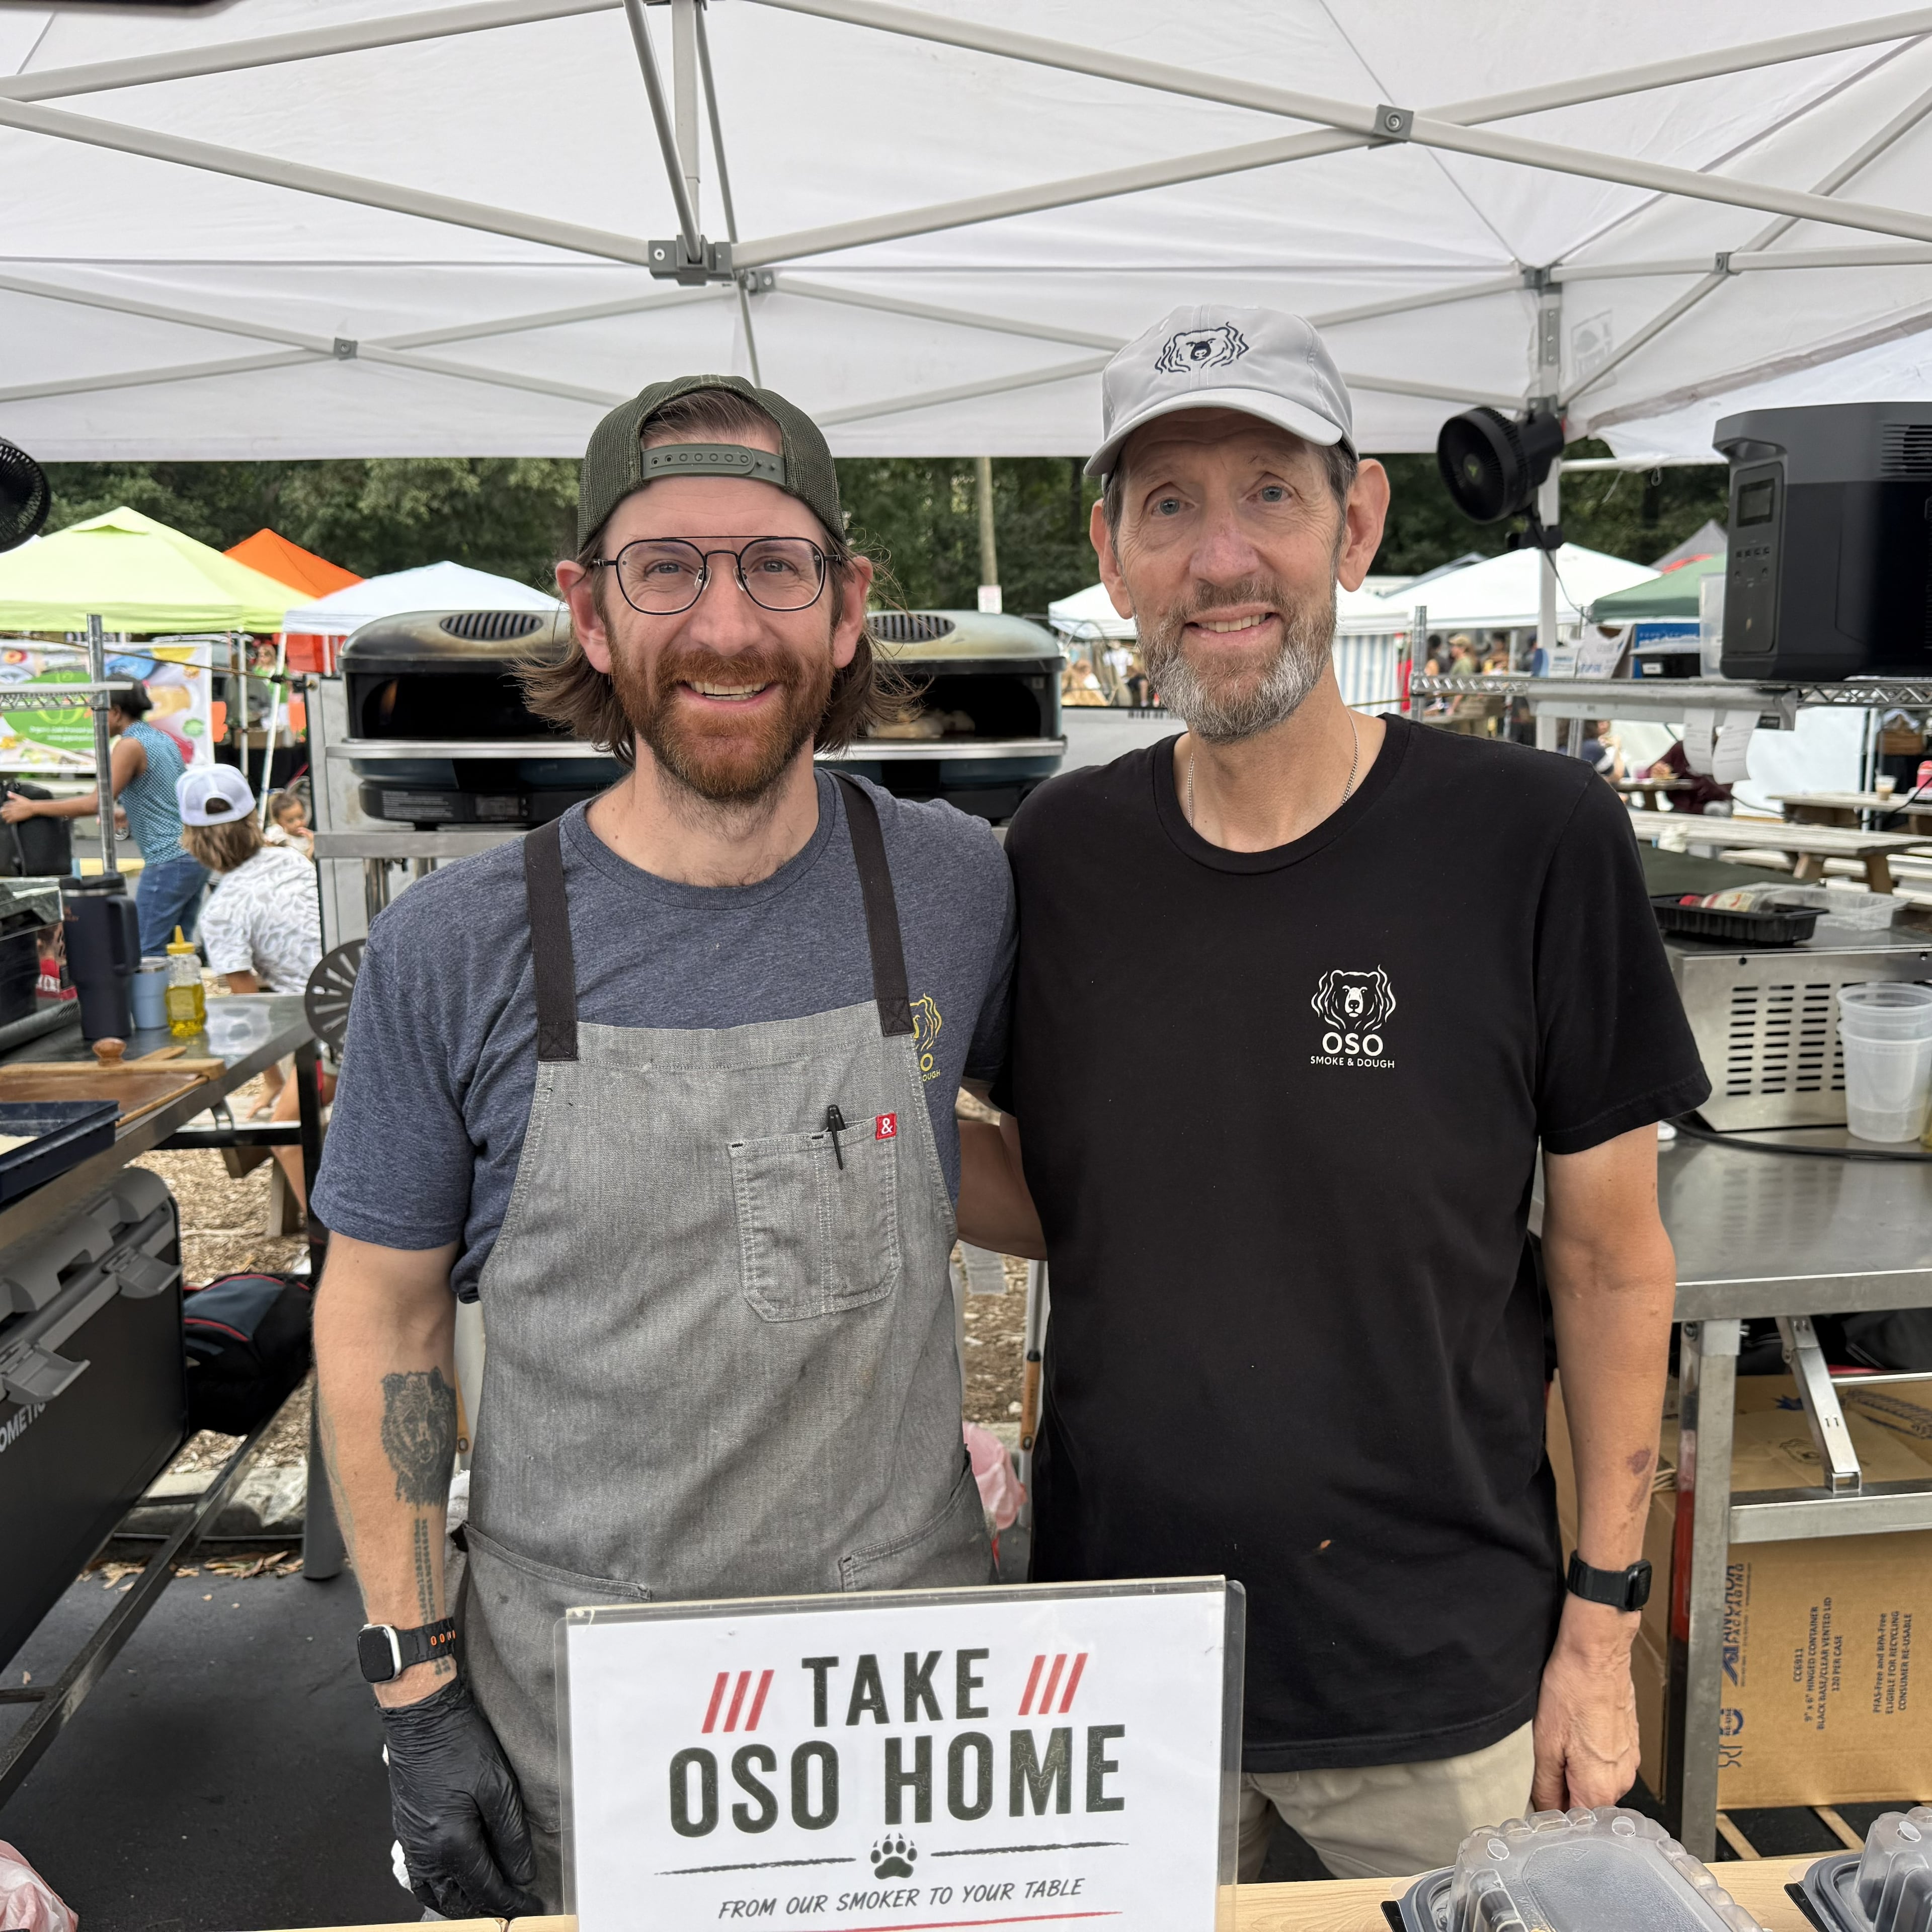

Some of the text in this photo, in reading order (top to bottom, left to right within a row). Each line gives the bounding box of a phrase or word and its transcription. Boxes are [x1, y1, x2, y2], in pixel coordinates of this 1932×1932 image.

[1310, 1056, 1395, 1068] SMOKE & DOUGH
[1322, 1032, 1384, 1057] OSO
[922, 1069, 941, 1082] OUGH
[881, 1117, 893, 1135] &
[0, 1402, 46, 1453] OMETI
[1808, 1606, 1818, 1656] CONTAINER
[1834, 1636, 1842, 1656] CASE
[1807, 1658, 1815, 1692] HINGED
[1816, 1597, 1831, 1730] BLACK BASE/CLEAR VENTED LID
[1832, 1658, 1841, 1674] PER
[1885, 1611, 1899, 1714] ELIGIBLE FOR RECYCLING
[1898, 1614, 1912, 1711] CONSUMER RE-USABLE
[801, 1648, 990, 1727] TAKE
[670, 1723, 1125, 1837] OSO HOME
[718, 1878, 1085, 1918] FROM OUR SMOKER TO YOUR TABLE
